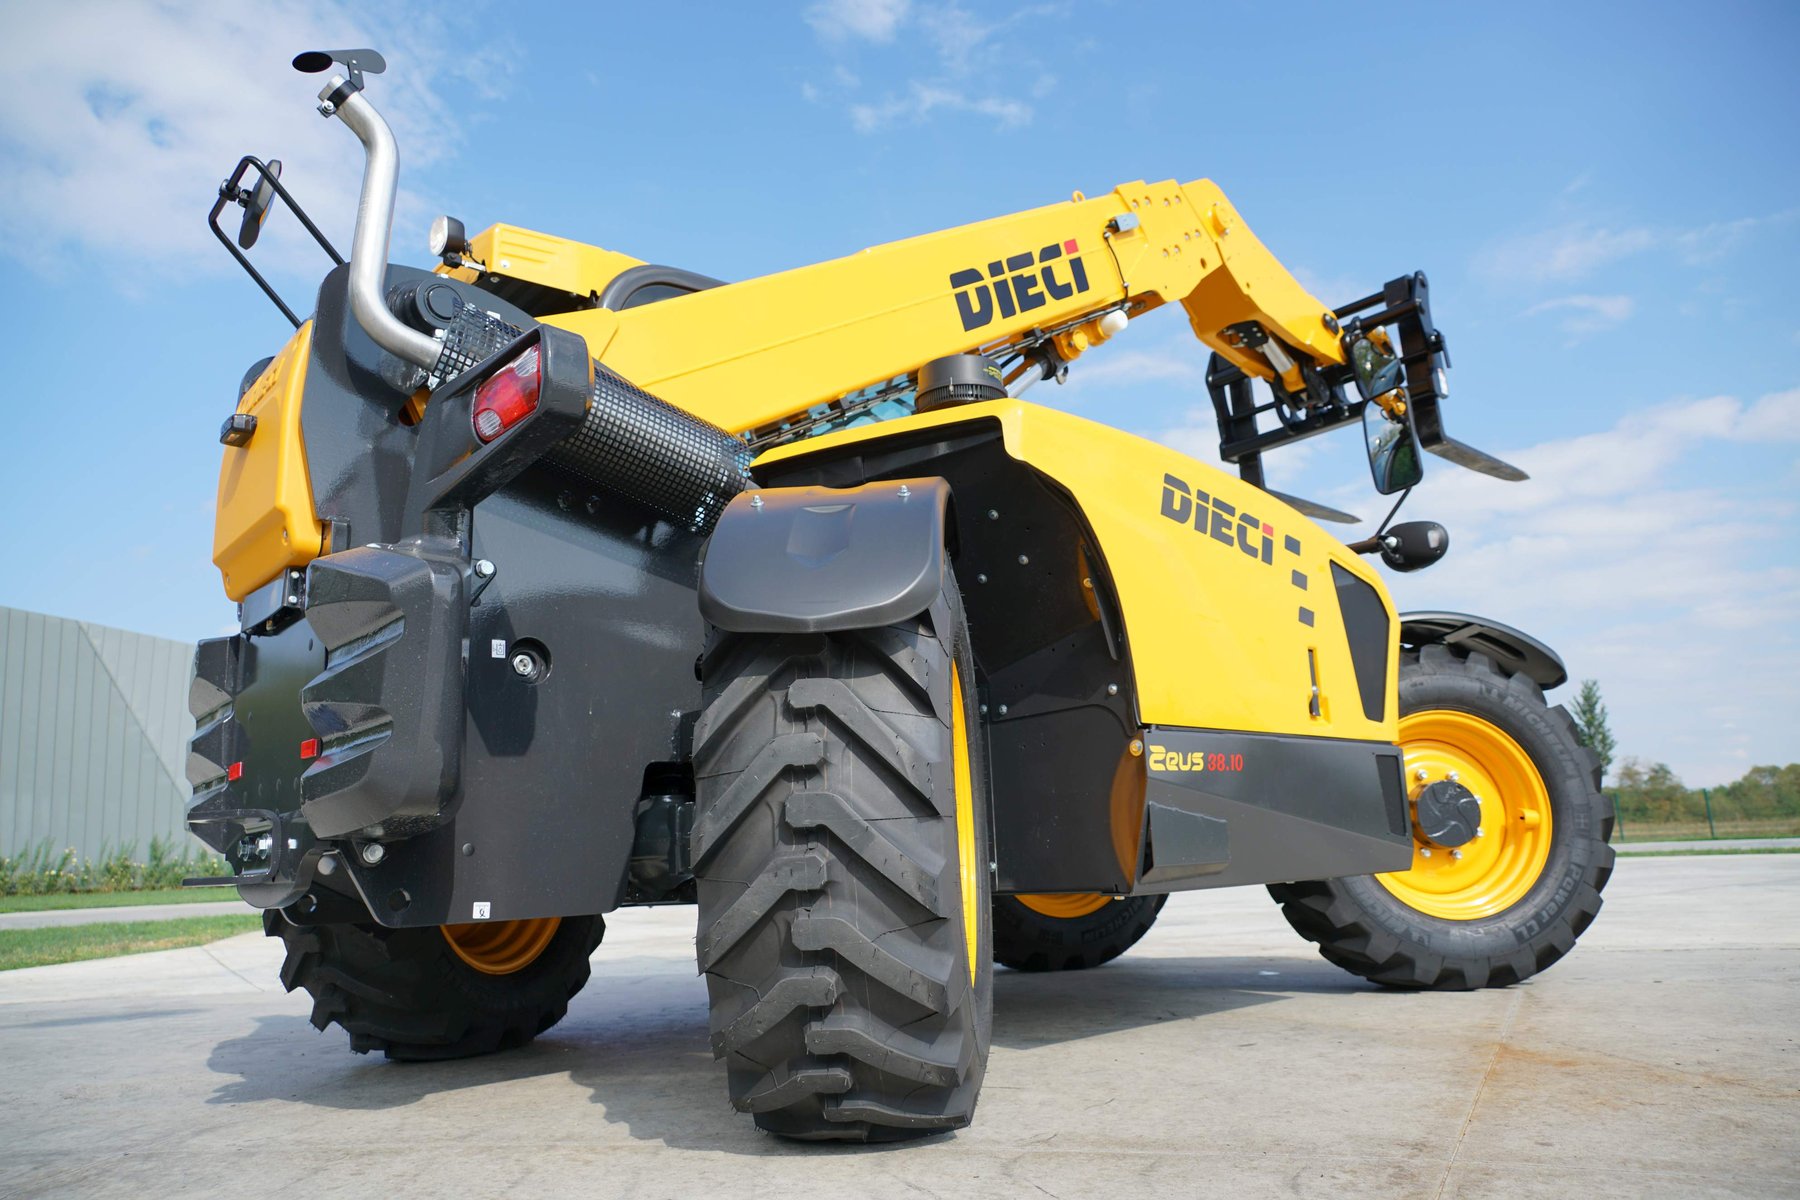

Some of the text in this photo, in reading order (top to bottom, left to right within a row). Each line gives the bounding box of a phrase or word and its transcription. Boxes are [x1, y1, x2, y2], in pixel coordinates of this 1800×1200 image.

[1207, 753, 1244, 772] 38.10
[1502, 695, 1581, 778] MICHELIN
[1515, 863, 1583, 940] Power CL
